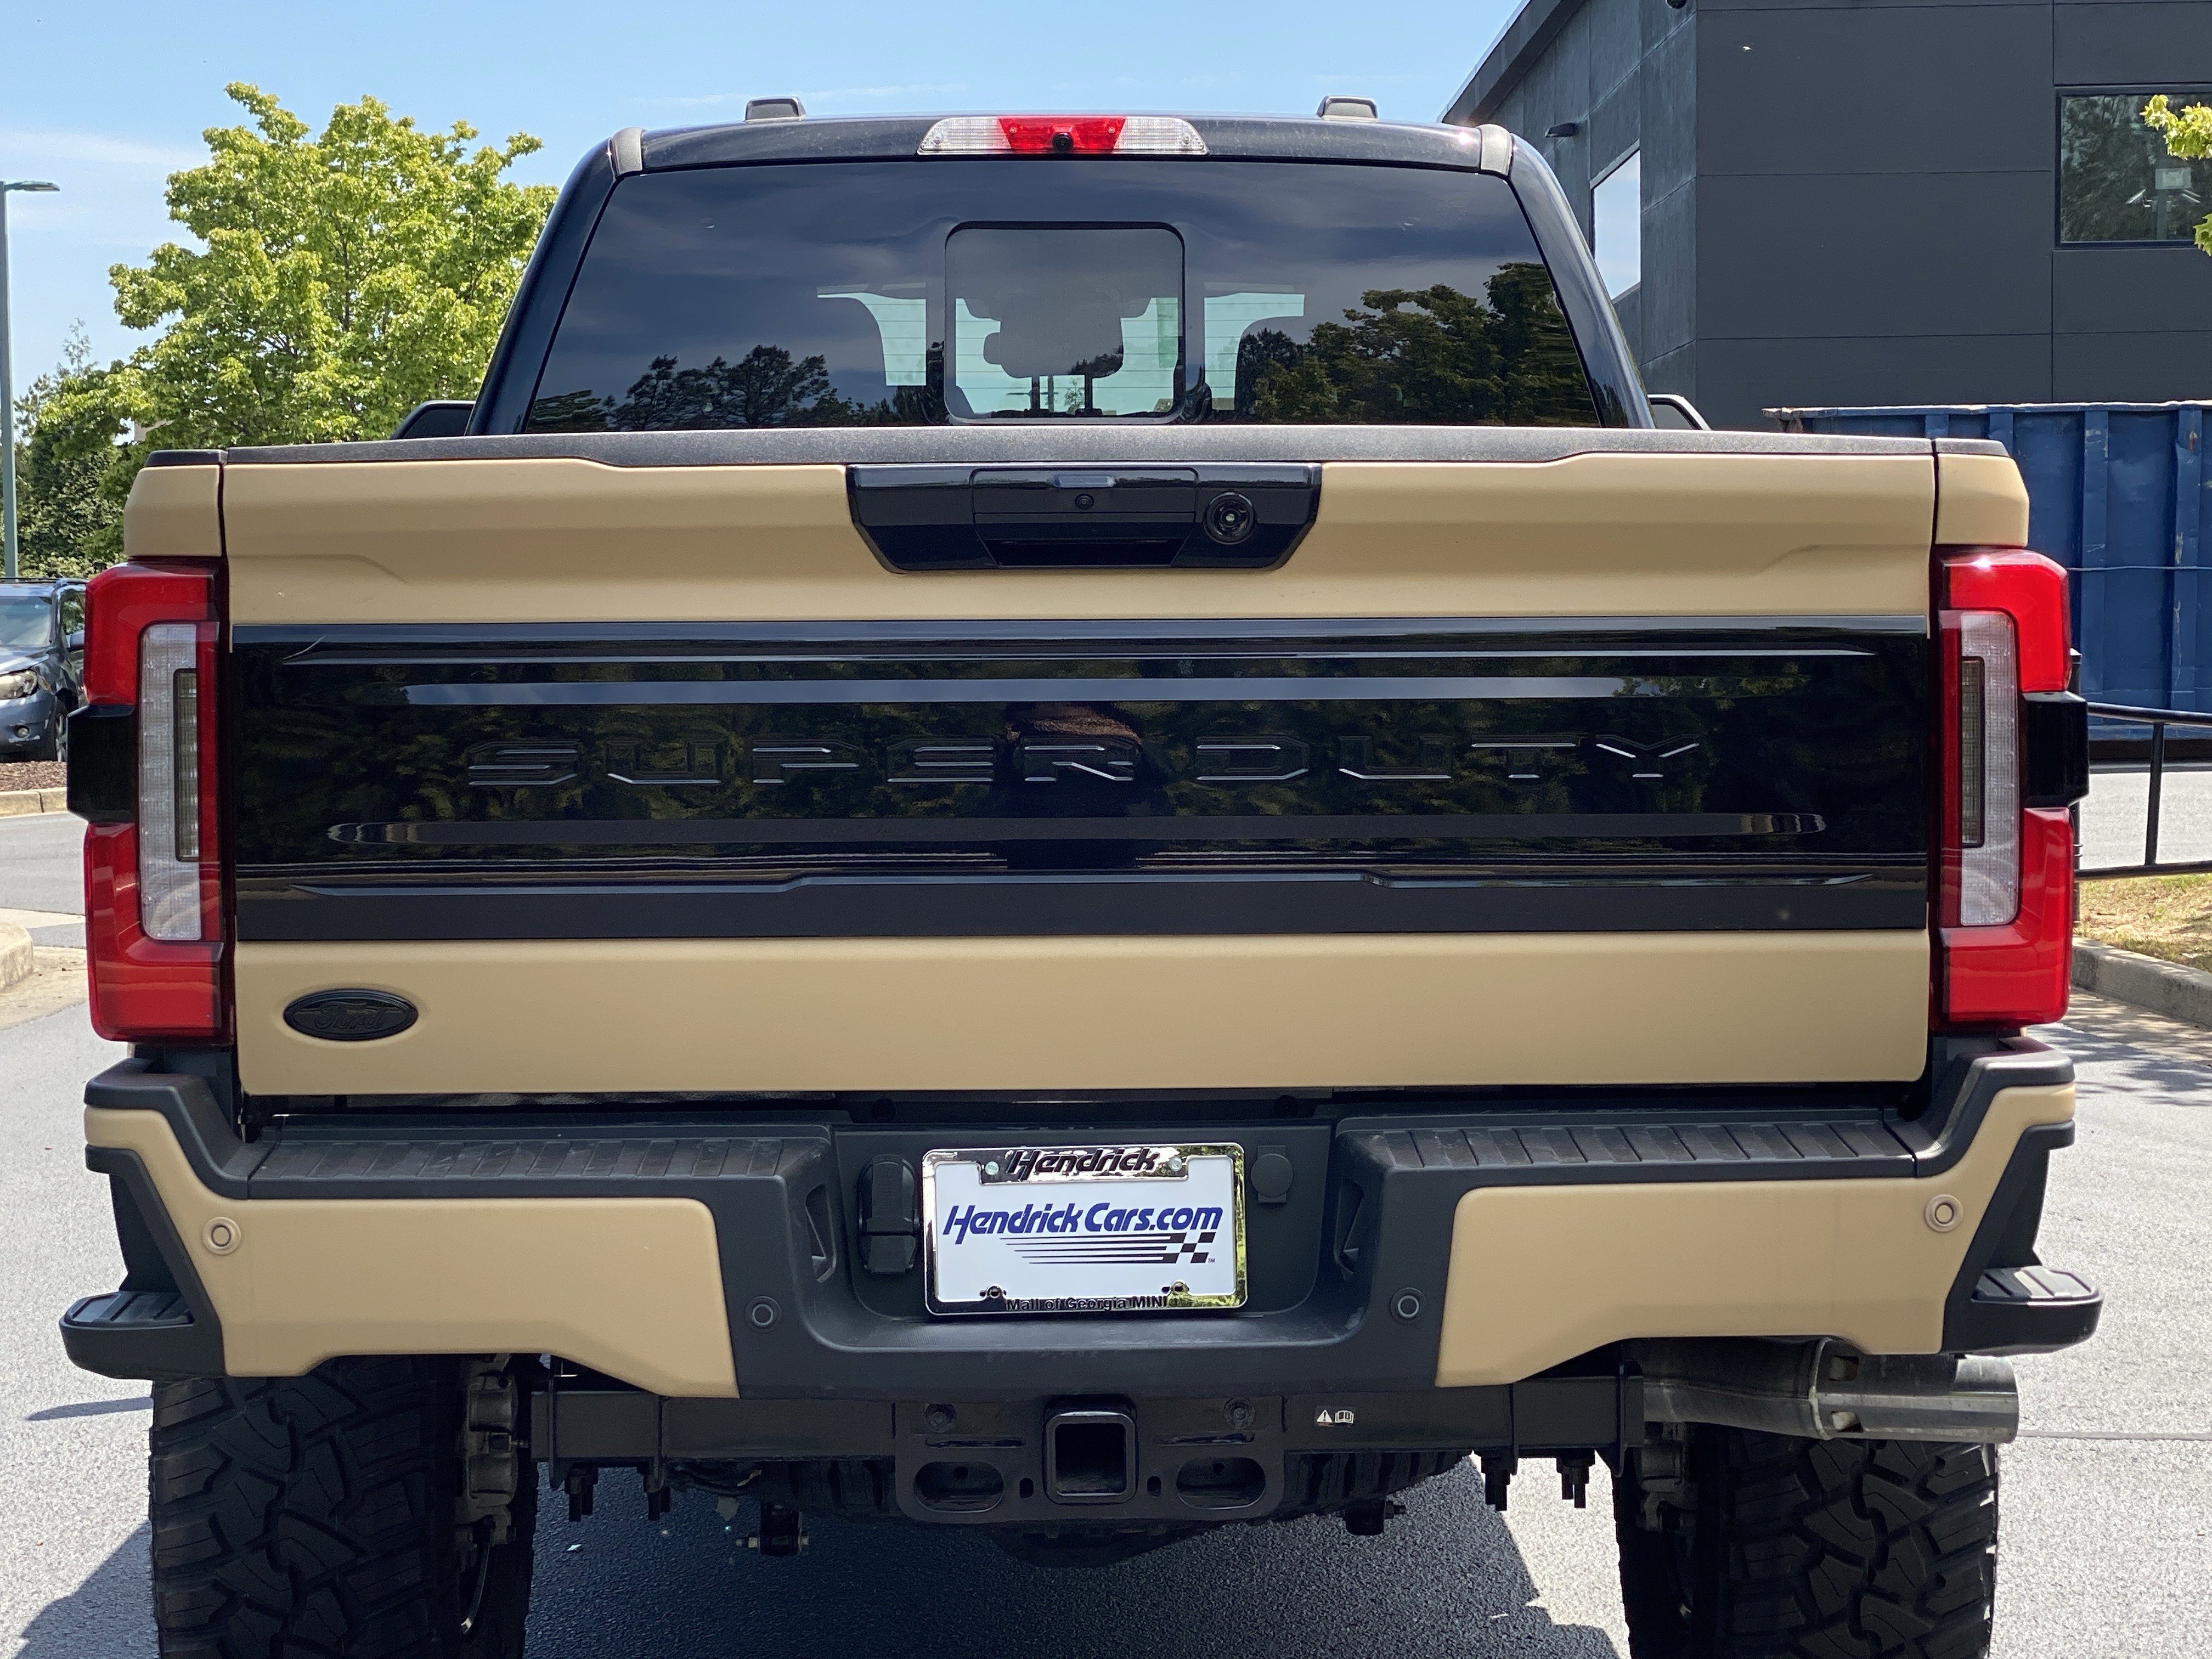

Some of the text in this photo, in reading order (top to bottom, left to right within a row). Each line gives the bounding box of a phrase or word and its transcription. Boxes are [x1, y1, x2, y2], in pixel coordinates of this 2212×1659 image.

[466, 733, 1702, 786] SUPER DUTY
[1007, 1147, 1160, 1181] Hendrick
[1006, 1295, 1167, 1311] Mall of Georgia MINI
